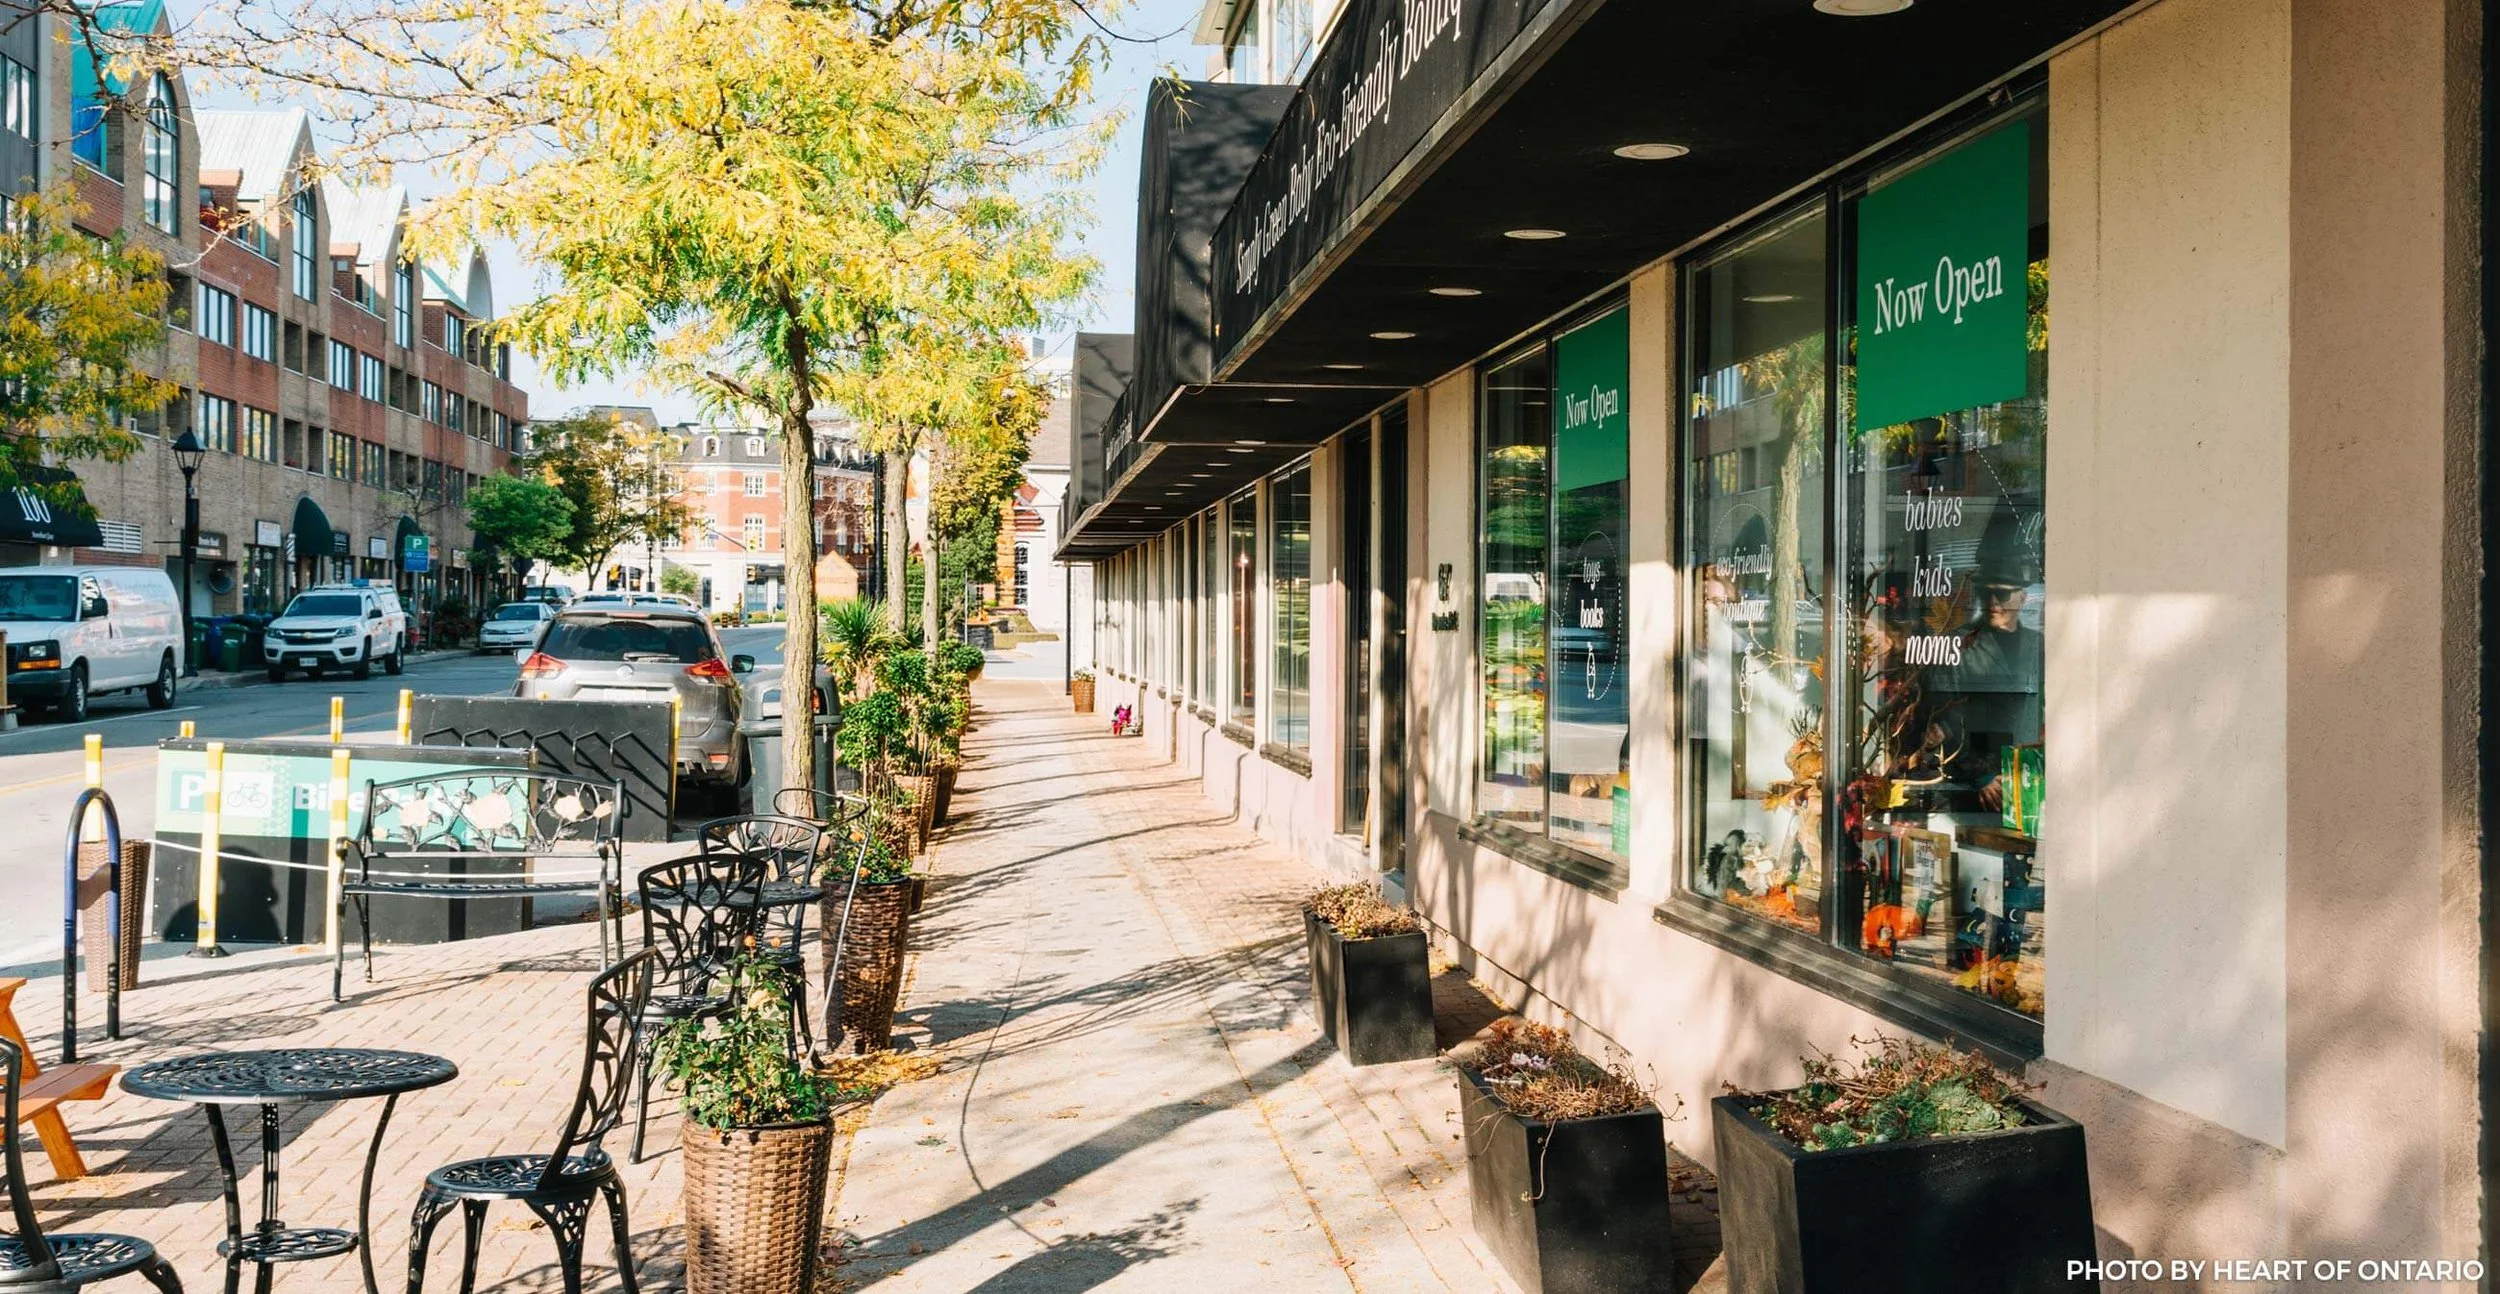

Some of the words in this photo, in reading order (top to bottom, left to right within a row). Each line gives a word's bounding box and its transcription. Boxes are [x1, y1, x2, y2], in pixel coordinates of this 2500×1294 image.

[1236, 216, 1262, 295] Simply
[1263, 194, 1287, 258] Green
[1289, 144, 1314, 223] Baby
[1315, 20, 1398, 190] Eco-Friendly
[1400, 0, 1461, 80] Bou
[1874, 277, 1928, 335] Now
[1935, 255, 2003, 325] Open
[1565, 393, 1589, 429] Now
[1591, 384, 1619, 429] Open
[1905, 485, 1963, 531] babies
[413, 538, 422, 549] P
[1583, 557, 1600, 591] toys
[1716, 544, 1773, 582] eco-friendly
[1913, 554, 1952, 598] kids
[1580, 599, 1604, 629] books
[1723, 594, 1765, 621] boutique
[1905, 633, 1961, 666] moms
[294, 783, 366, 813] Bie
